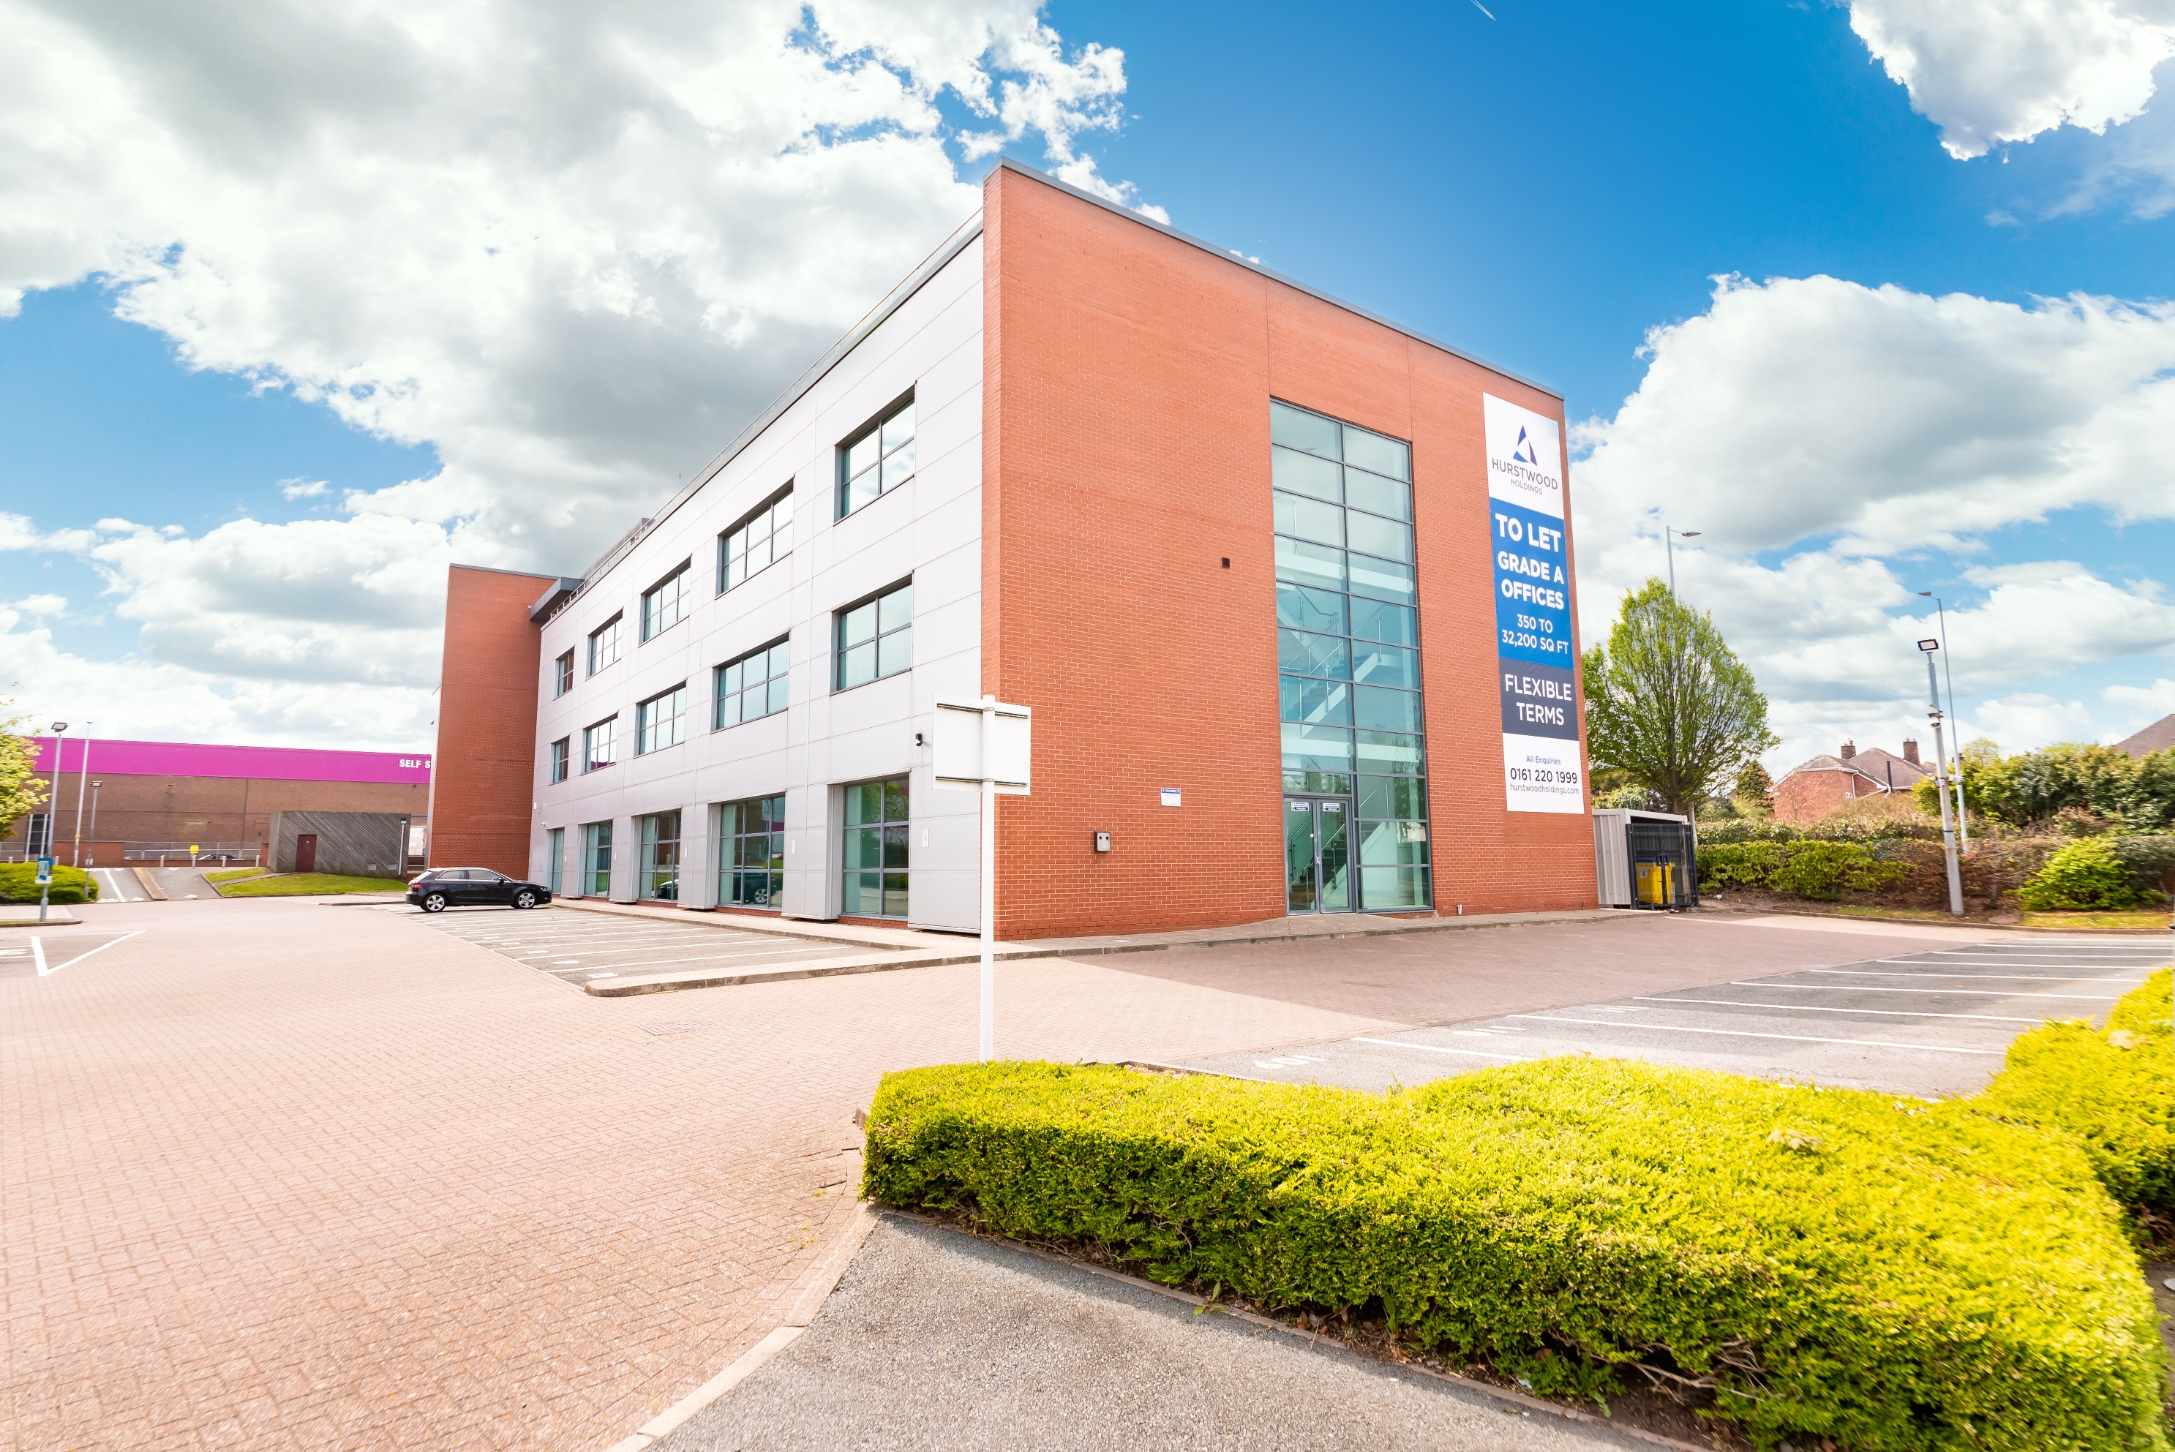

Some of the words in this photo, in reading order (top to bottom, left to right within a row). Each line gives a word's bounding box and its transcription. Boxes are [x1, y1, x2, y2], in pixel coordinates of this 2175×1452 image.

[1492, 458, 1558, 490] HURSTWOOD
[1510, 478, 1542, 495] HOLDINGS
[1495, 512, 1522, 542] TO
[1528, 522, 1561, 552] LET
[1498, 551, 1550, 580] GRADE
[1554, 566, 1564, 584] A
[1501, 578, 1564, 610] OFFICES
[1517, 614, 1536, 630] 350
[1538, 618, 1553, 633] TO
[1502, 630, 1537, 648] 32,200
[1540, 637, 1554, 652] SQ
[1557, 640, 1569, 655] FT
[1504, 674, 1572, 701] FLEXIBLE
[1516, 702, 1564, 726] TERMS
[399, 758, 421, 768] SELF
[1535, 756, 1561, 766] Enquiries
[1510, 768, 1532, 781] 0161
[1535, 770, 1553, 782] 220
[1556, 771, 1577, 784] 1999
[1510, 783, 1579, 795] hurstwoodholdings.com
